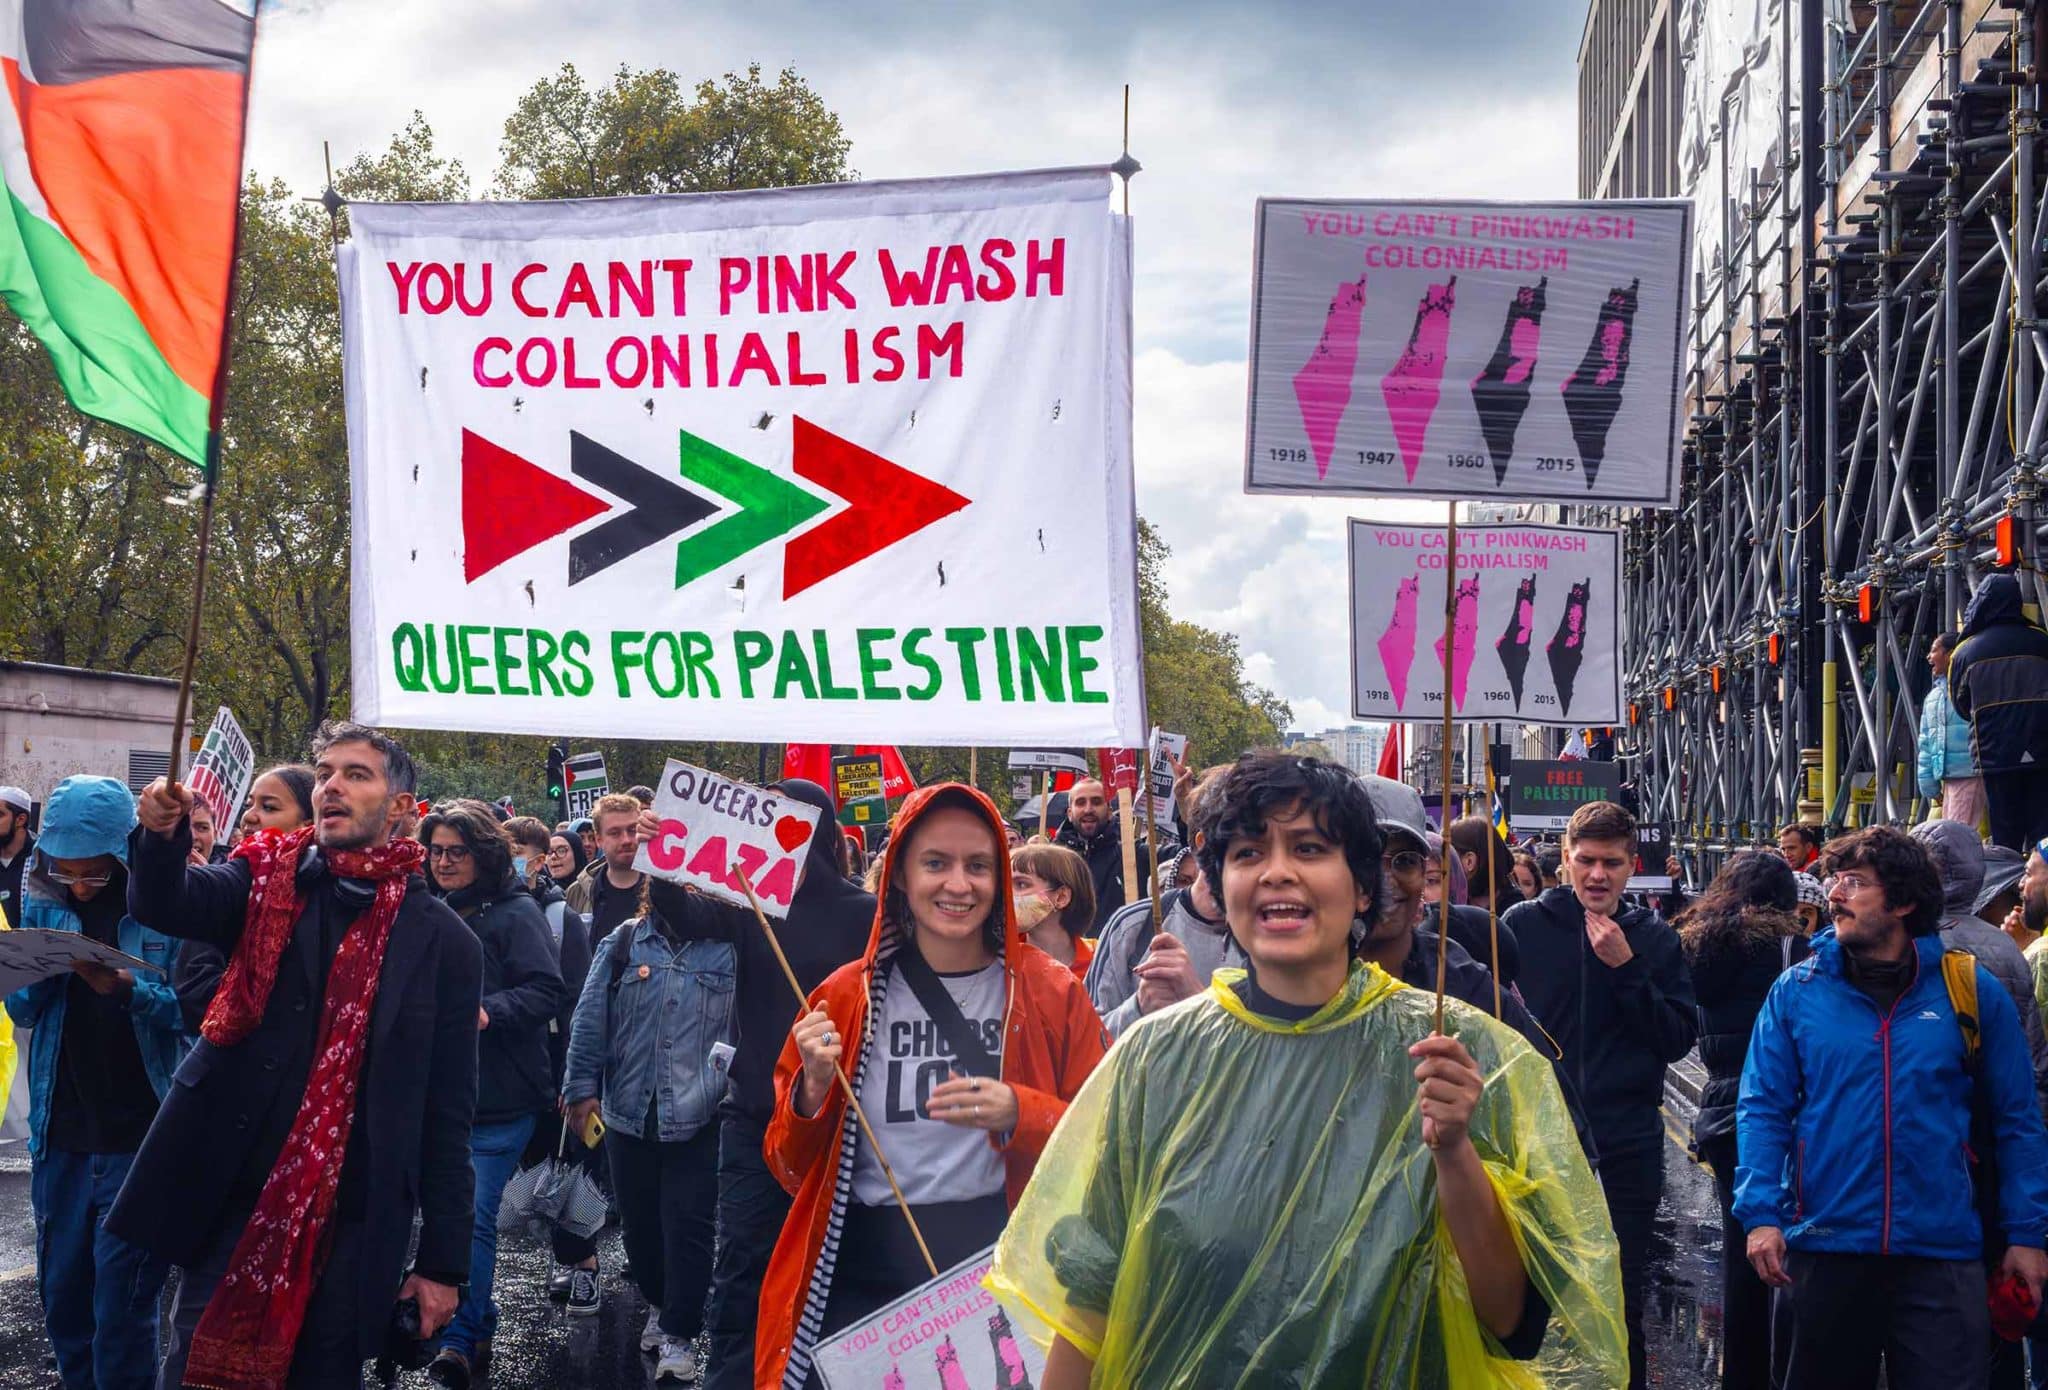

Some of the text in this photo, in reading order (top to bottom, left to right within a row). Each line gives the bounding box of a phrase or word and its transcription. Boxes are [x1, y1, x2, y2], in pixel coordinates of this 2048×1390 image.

[1303, 213, 1635, 240] YOU CAN'T PINKWASH
[1365, 245, 1568, 271] COLONIALISM
[386, 238, 1065, 318] YOU CAN'T PINK WASH
[473, 322, 963, 388] COLONIALISM
[1269, 449, 1575, 472] 1918 1947 1960 2015
[1375, 531, 1414, 547] YOU
[1485, 532, 1587, 552] PINKWASH
[392, 622, 1109, 703] QUEERS FOR PALESTINE
[1366, 690, 1390, 701] 1918
[1483, 691, 1510, 701] 1960
[1534, 694, 1555, 704] 2015
[844, 764, 871, 772] BLACK
[1546, 771, 1584, 785] FREE
[670, 770, 777, 827] QUEERS
[849, 782, 870, 790] FREE
[1523, 785, 1608, 801] PALESTINE
[647, 819, 796, 906] GAZA
[840, 1327, 879, 1355] YOU
[883, 1296, 934, 1334] CAN'T
[887, 1291, 993, 1357] COLONIALIS
